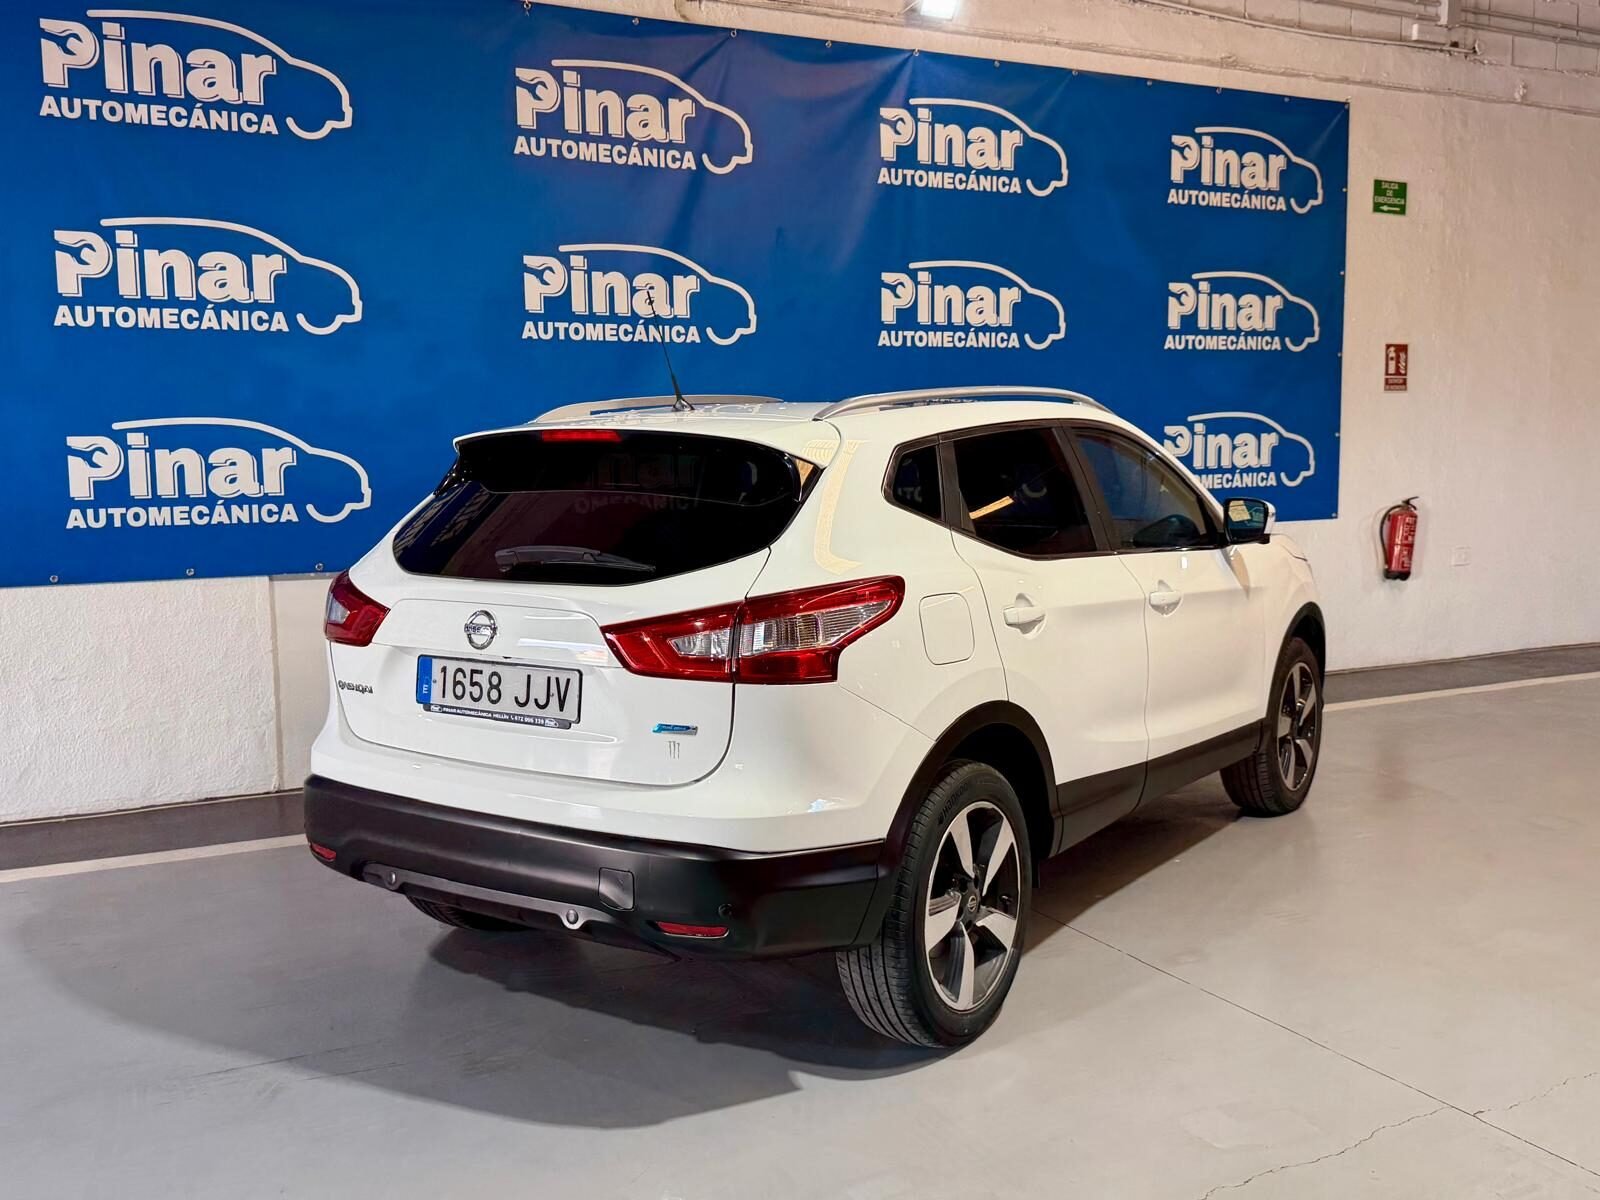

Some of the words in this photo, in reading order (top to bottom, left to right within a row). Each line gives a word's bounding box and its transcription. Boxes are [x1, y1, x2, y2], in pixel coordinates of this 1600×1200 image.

[40, 19, 276, 105] Pinar
[40, 96, 278, 135] AUTOMECÁNICA
[516, 66, 695, 143] Pinar
[514, 136, 696, 170] AUTOMECÁNICA
[880, 108, 1023, 170] Pinar
[877, 168, 1021, 193] AUTOMECÁNICA
[1171, 135, 1286, 191] Pinar
[1168, 189, 1286, 211] AUTOMECÁNICA
[54, 230, 287, 303] Pinar
[523, 255, 700, 318] Pinar
[54, 304, 289, 332] AUTOMECÁNICA
[881, 271, 1021, 327] Pinar
[1168, 281, 1283, 331] Pinar
[522, 320, 700, 343] AUTOMECÁNICA
[878, 330, 1019, 348] AUTOMECÁNICA
[1164, 334, 1281, 351] AUTOMECÁNICA
[67, 433, 296, 500] Pinar
[1164, 423, 1279, 469] Pinar
[1193, 470, 1277, 489] MECÁNICA
[66, 500, 298, 528] AUTOMECÁNICA
[440, 665, 502, 705] 1658
[514, 673, 571, 713] JJV
